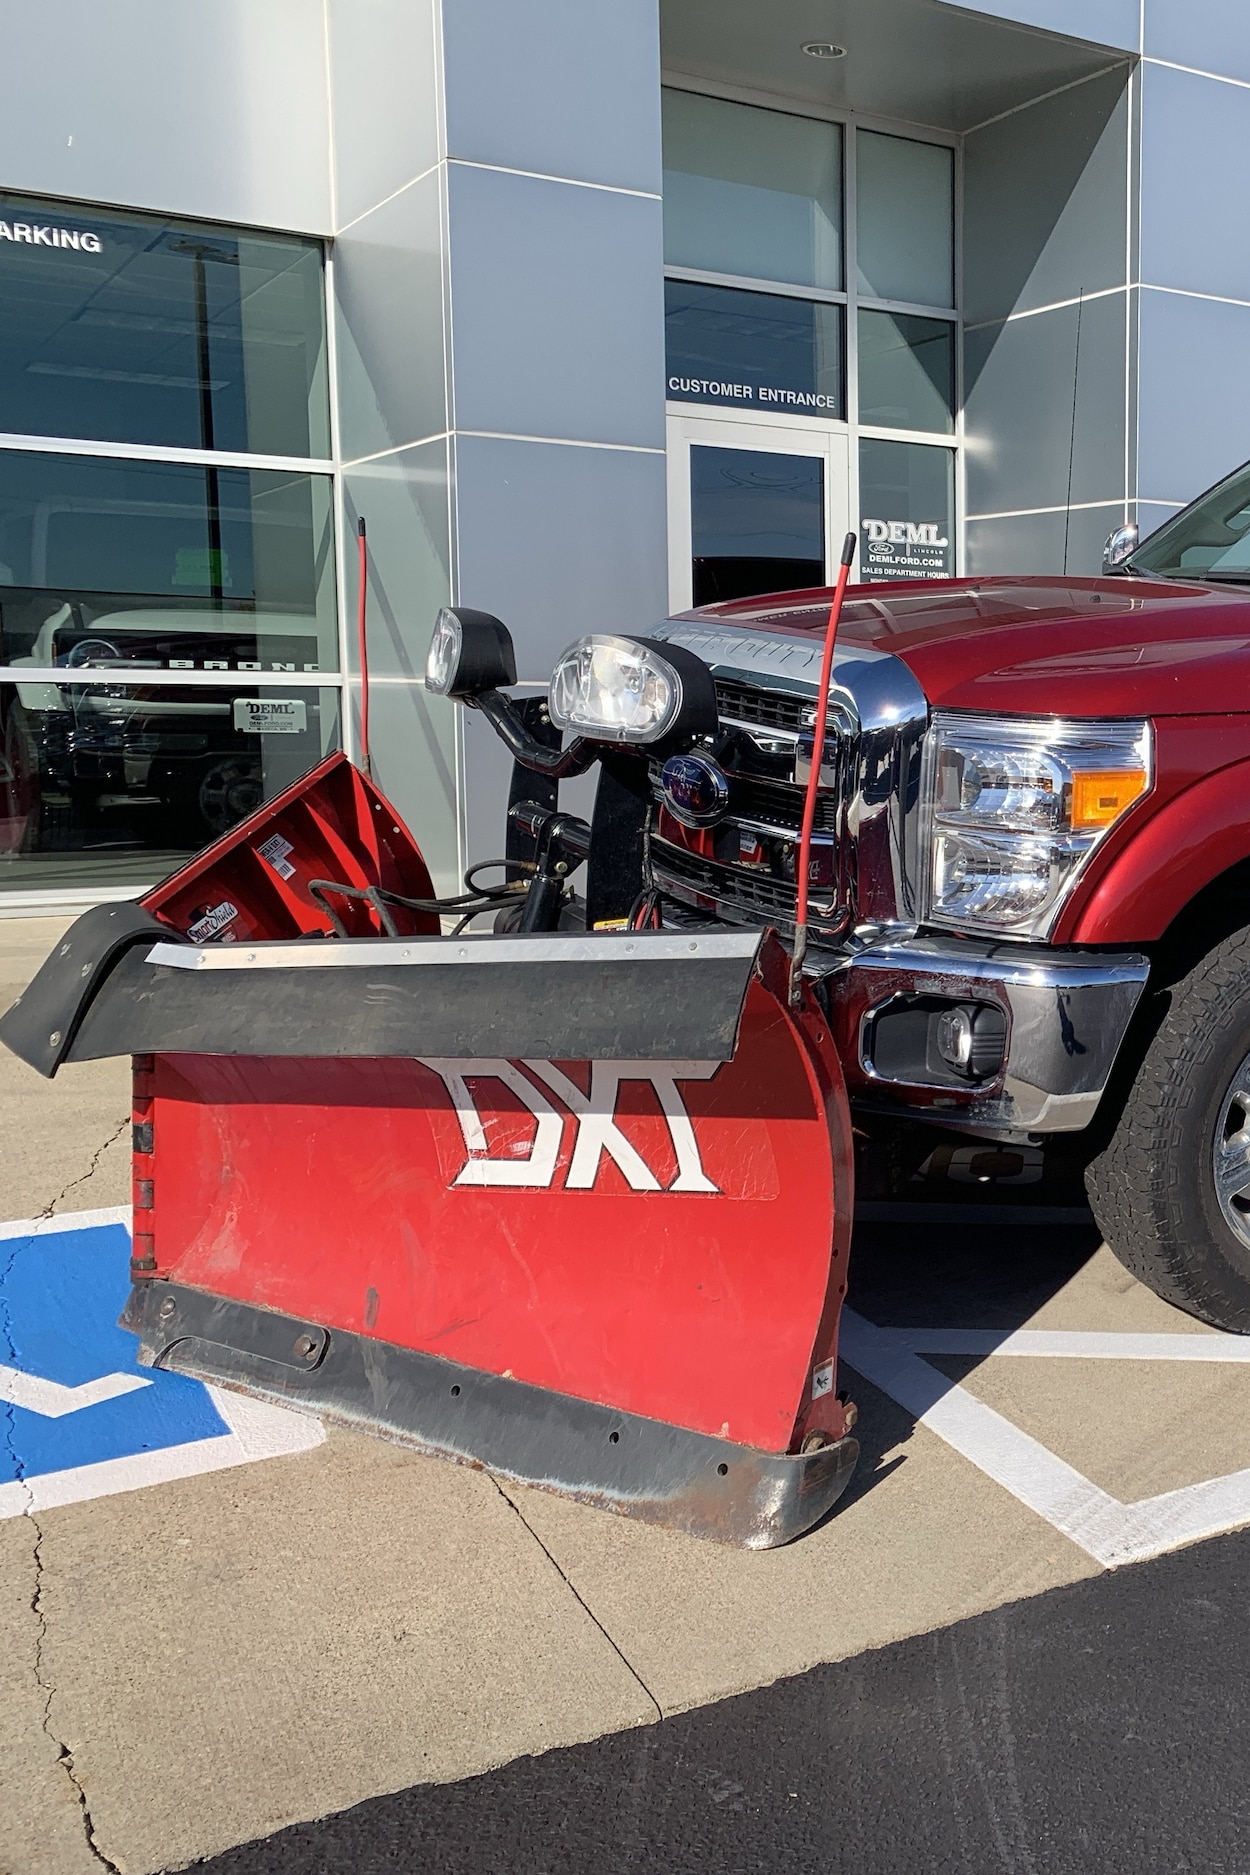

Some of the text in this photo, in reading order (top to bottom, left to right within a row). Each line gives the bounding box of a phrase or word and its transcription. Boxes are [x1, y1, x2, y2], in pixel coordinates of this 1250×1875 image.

[0, 221, 103, 253] ARKING
[668, 377, 835, 409] CUSTOMER ENTRANCE
[861, 518, 949, 548] DEML
[869, 555, 943, 567] DEMLFORD.COM
[861, 567, 949, 579] SALES DEPARTMENT HOURS
[168, 659, 320, 672] BRONC
[245, 701, 295, 714] DEML
